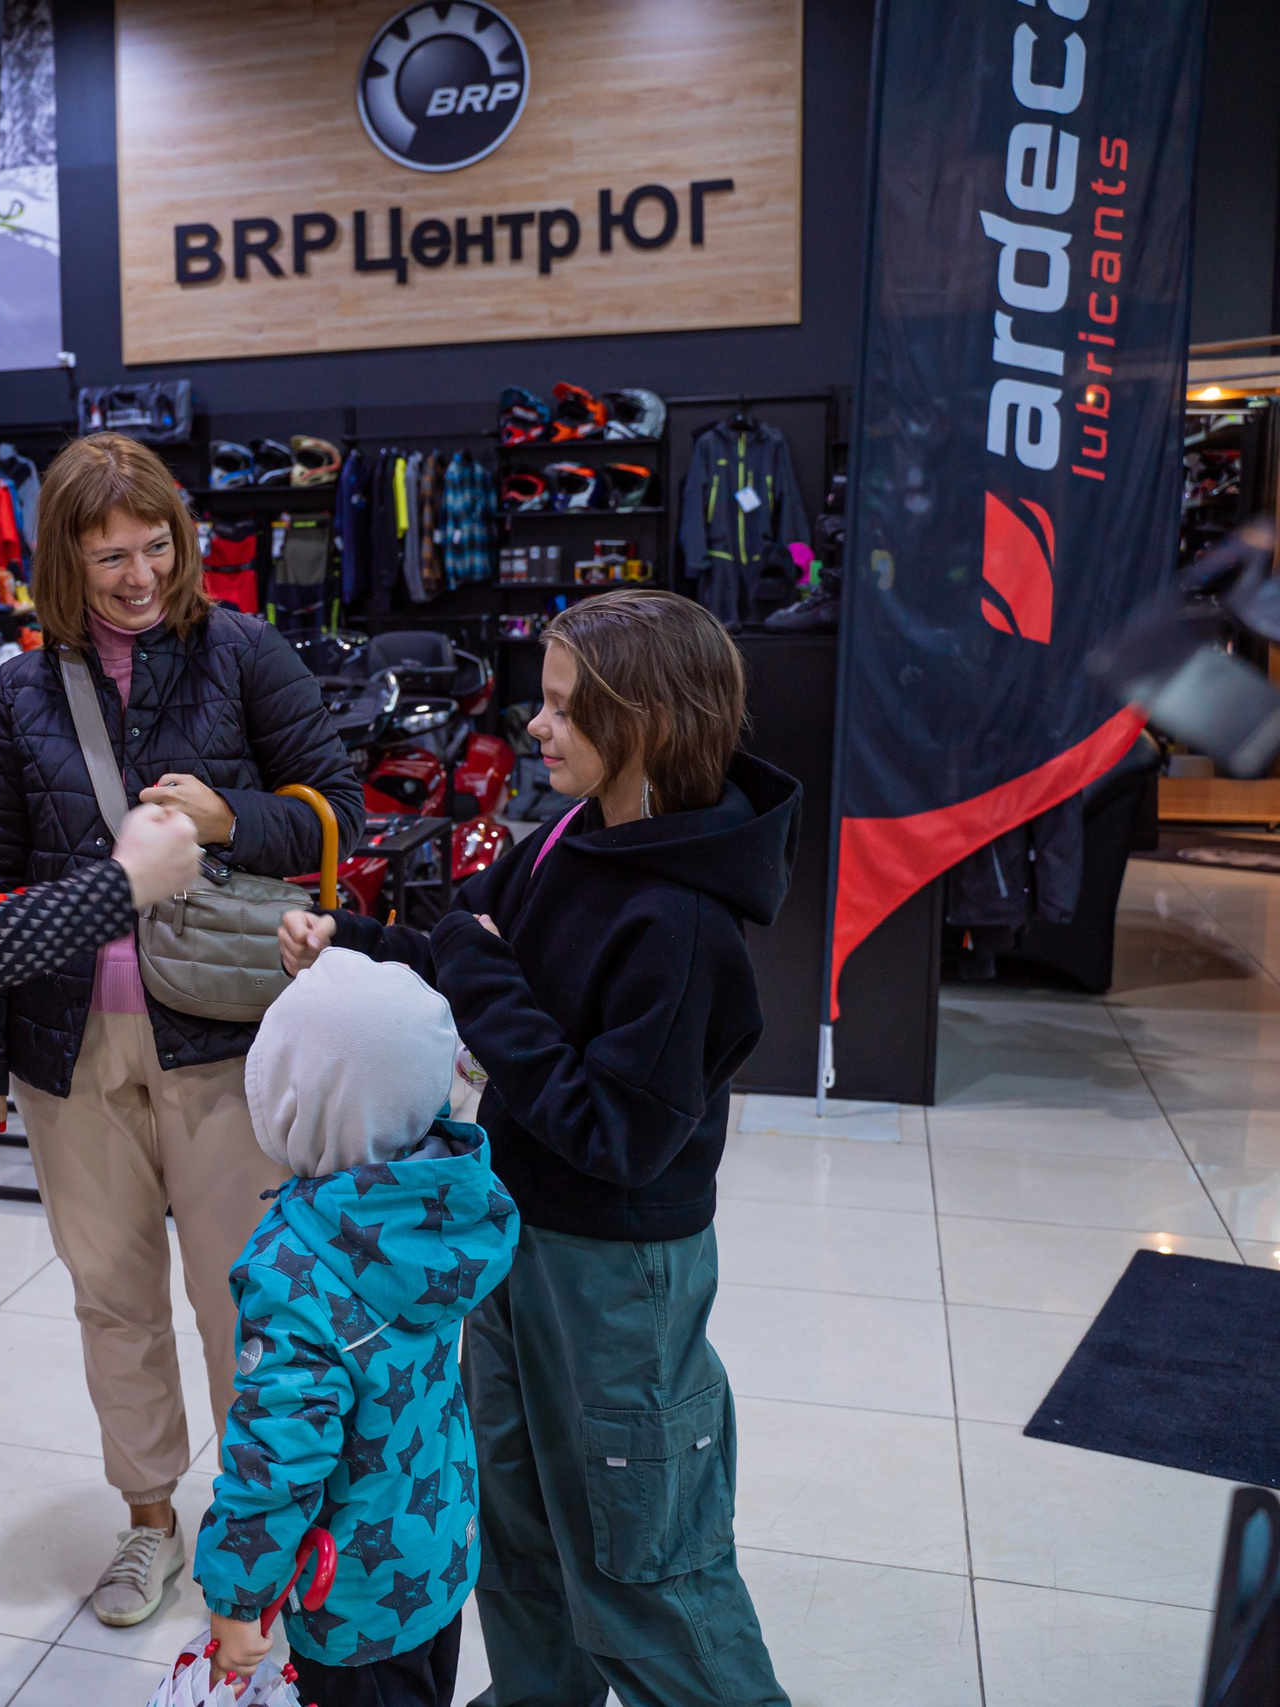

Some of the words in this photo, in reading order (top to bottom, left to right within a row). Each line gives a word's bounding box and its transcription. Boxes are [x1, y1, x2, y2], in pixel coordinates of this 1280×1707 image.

[426, 81, 521, 117] BRP
[173, 213, 338, 284] BRP
[353, 206, 580, 285] Центр
[599, 179, 734, 253] ЮГ
[979, 0, 1090, 471] ardec
[1071, 136, 1129, 481] lubricants
